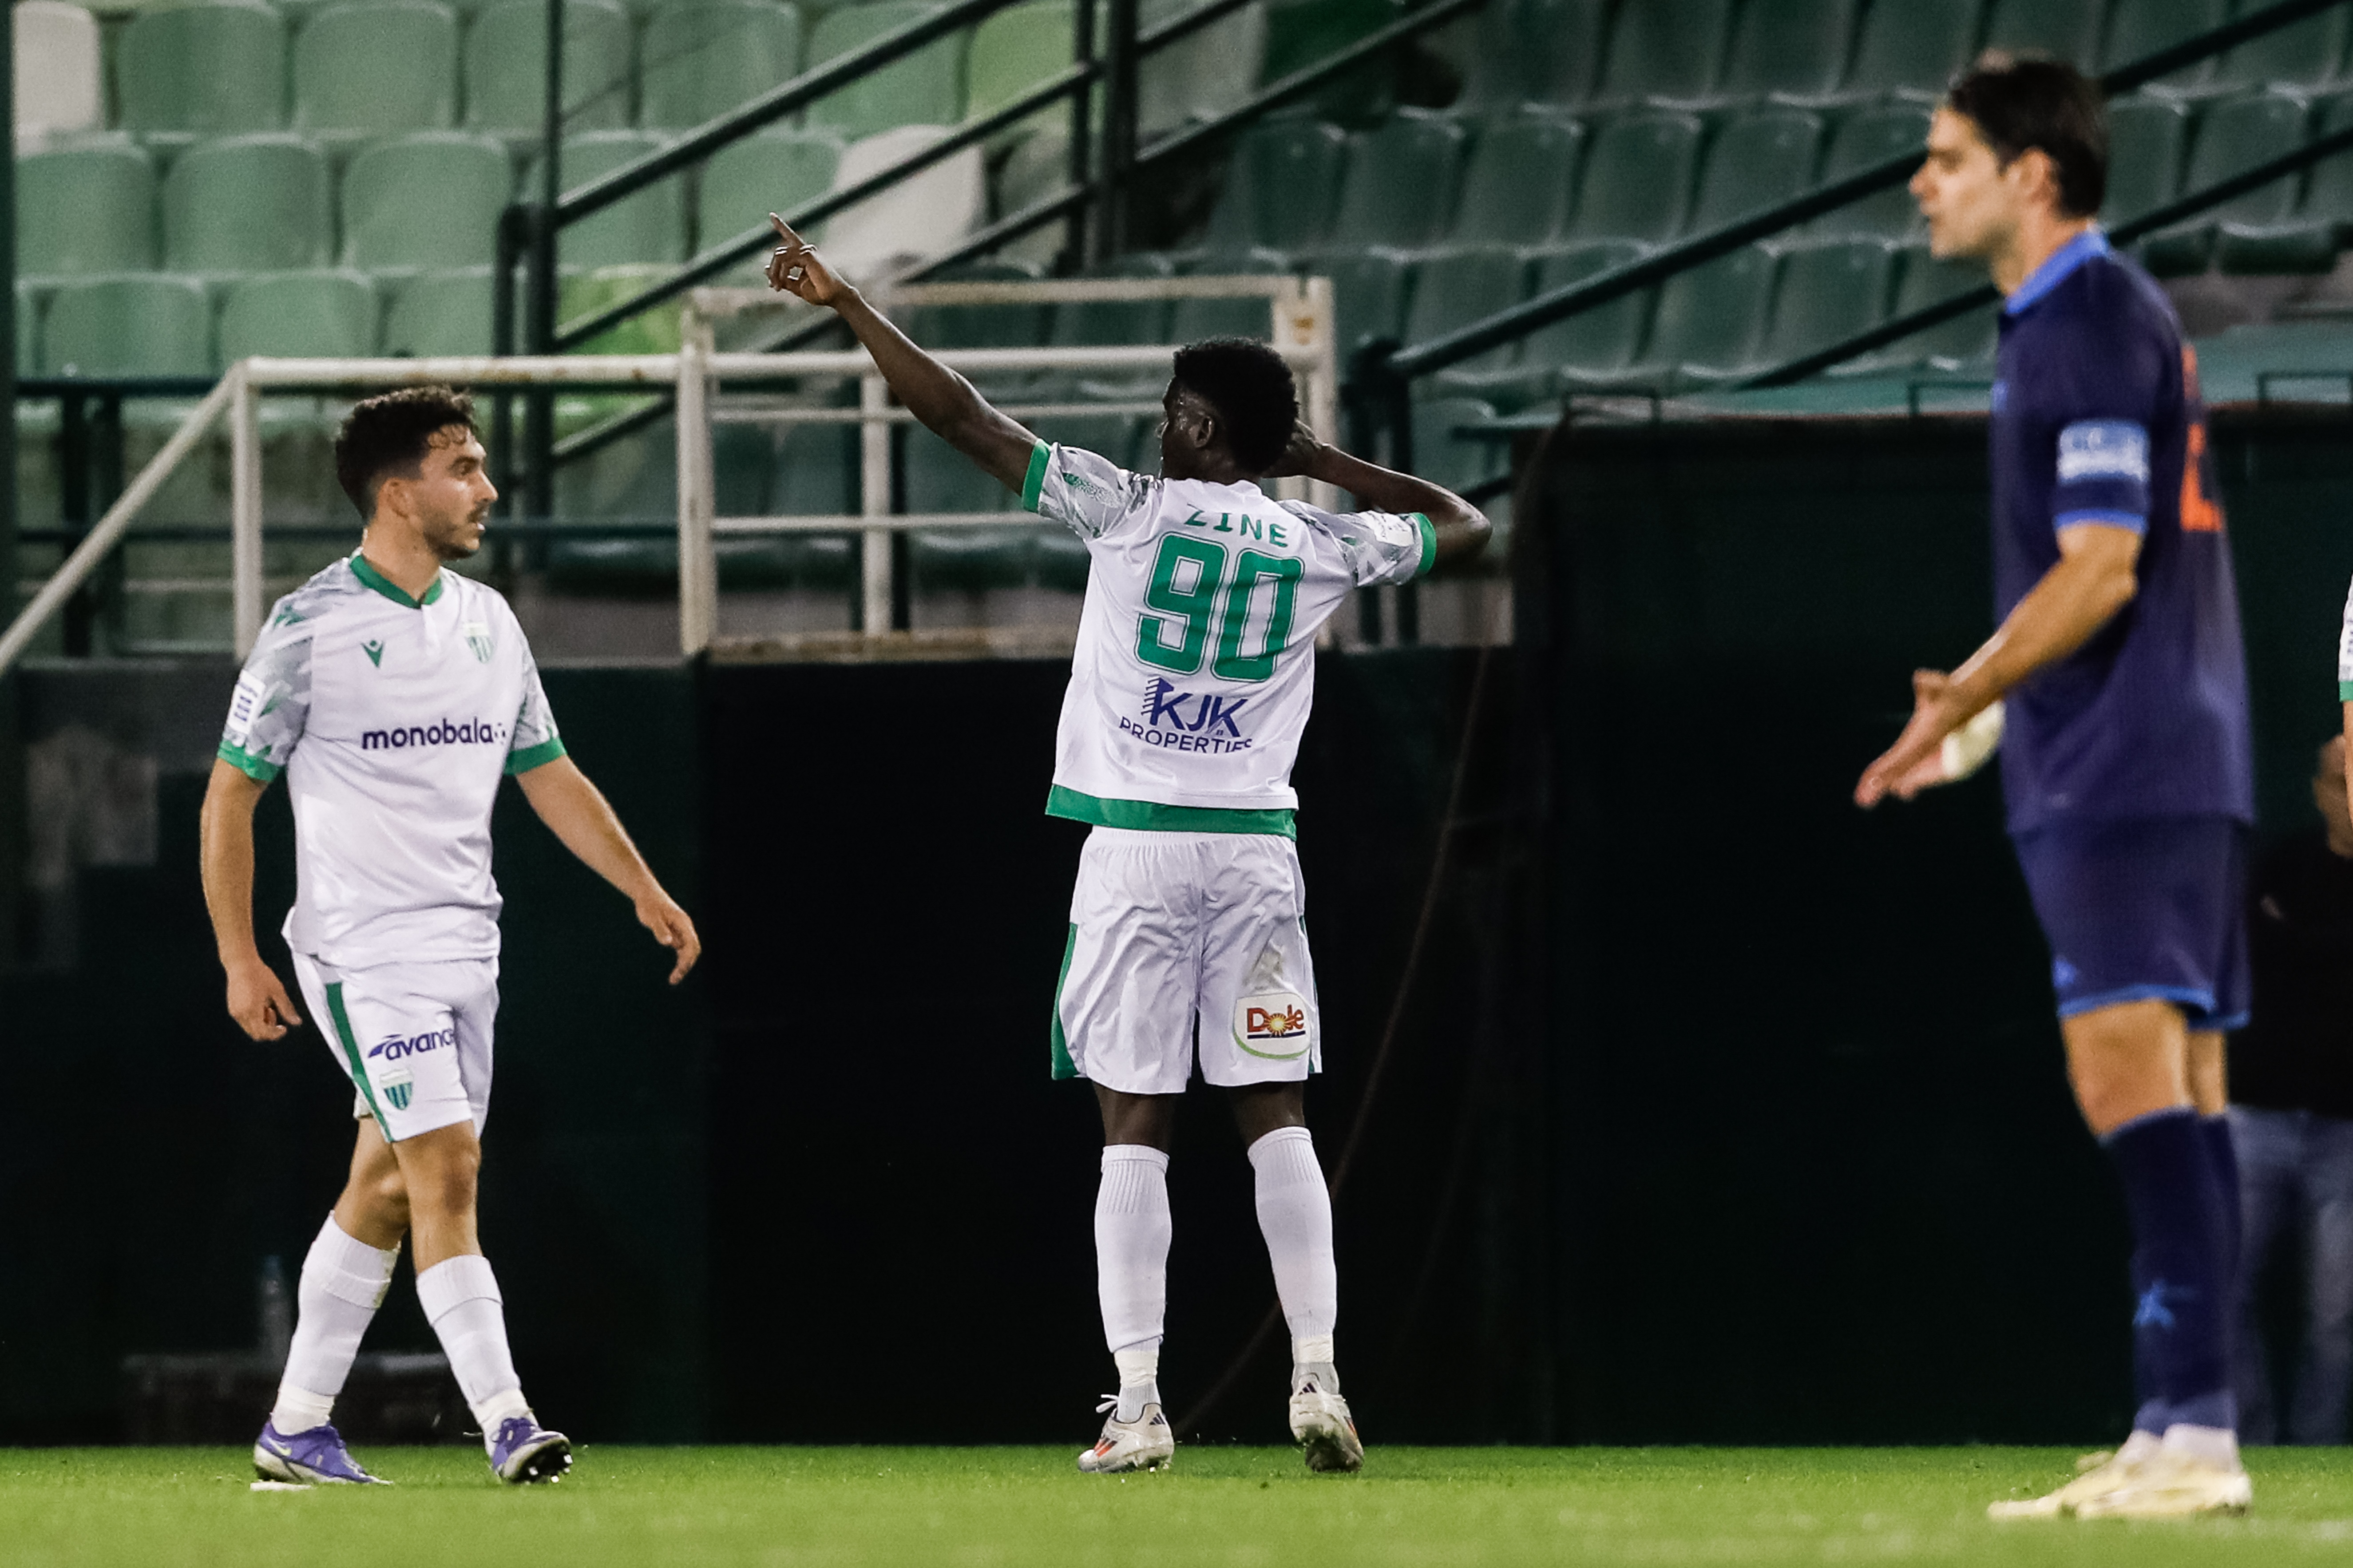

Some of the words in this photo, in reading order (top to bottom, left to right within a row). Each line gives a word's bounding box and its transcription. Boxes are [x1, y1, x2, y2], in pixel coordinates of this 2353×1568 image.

[1184, 502, 1288, 547] ZINE
[1134, 531, 1305, 682] 90
[1141, 677, 1248, 737] KJK
[362, 716, 494, 749] monobala
[1247, 1004, 1304, 1036] Dole
